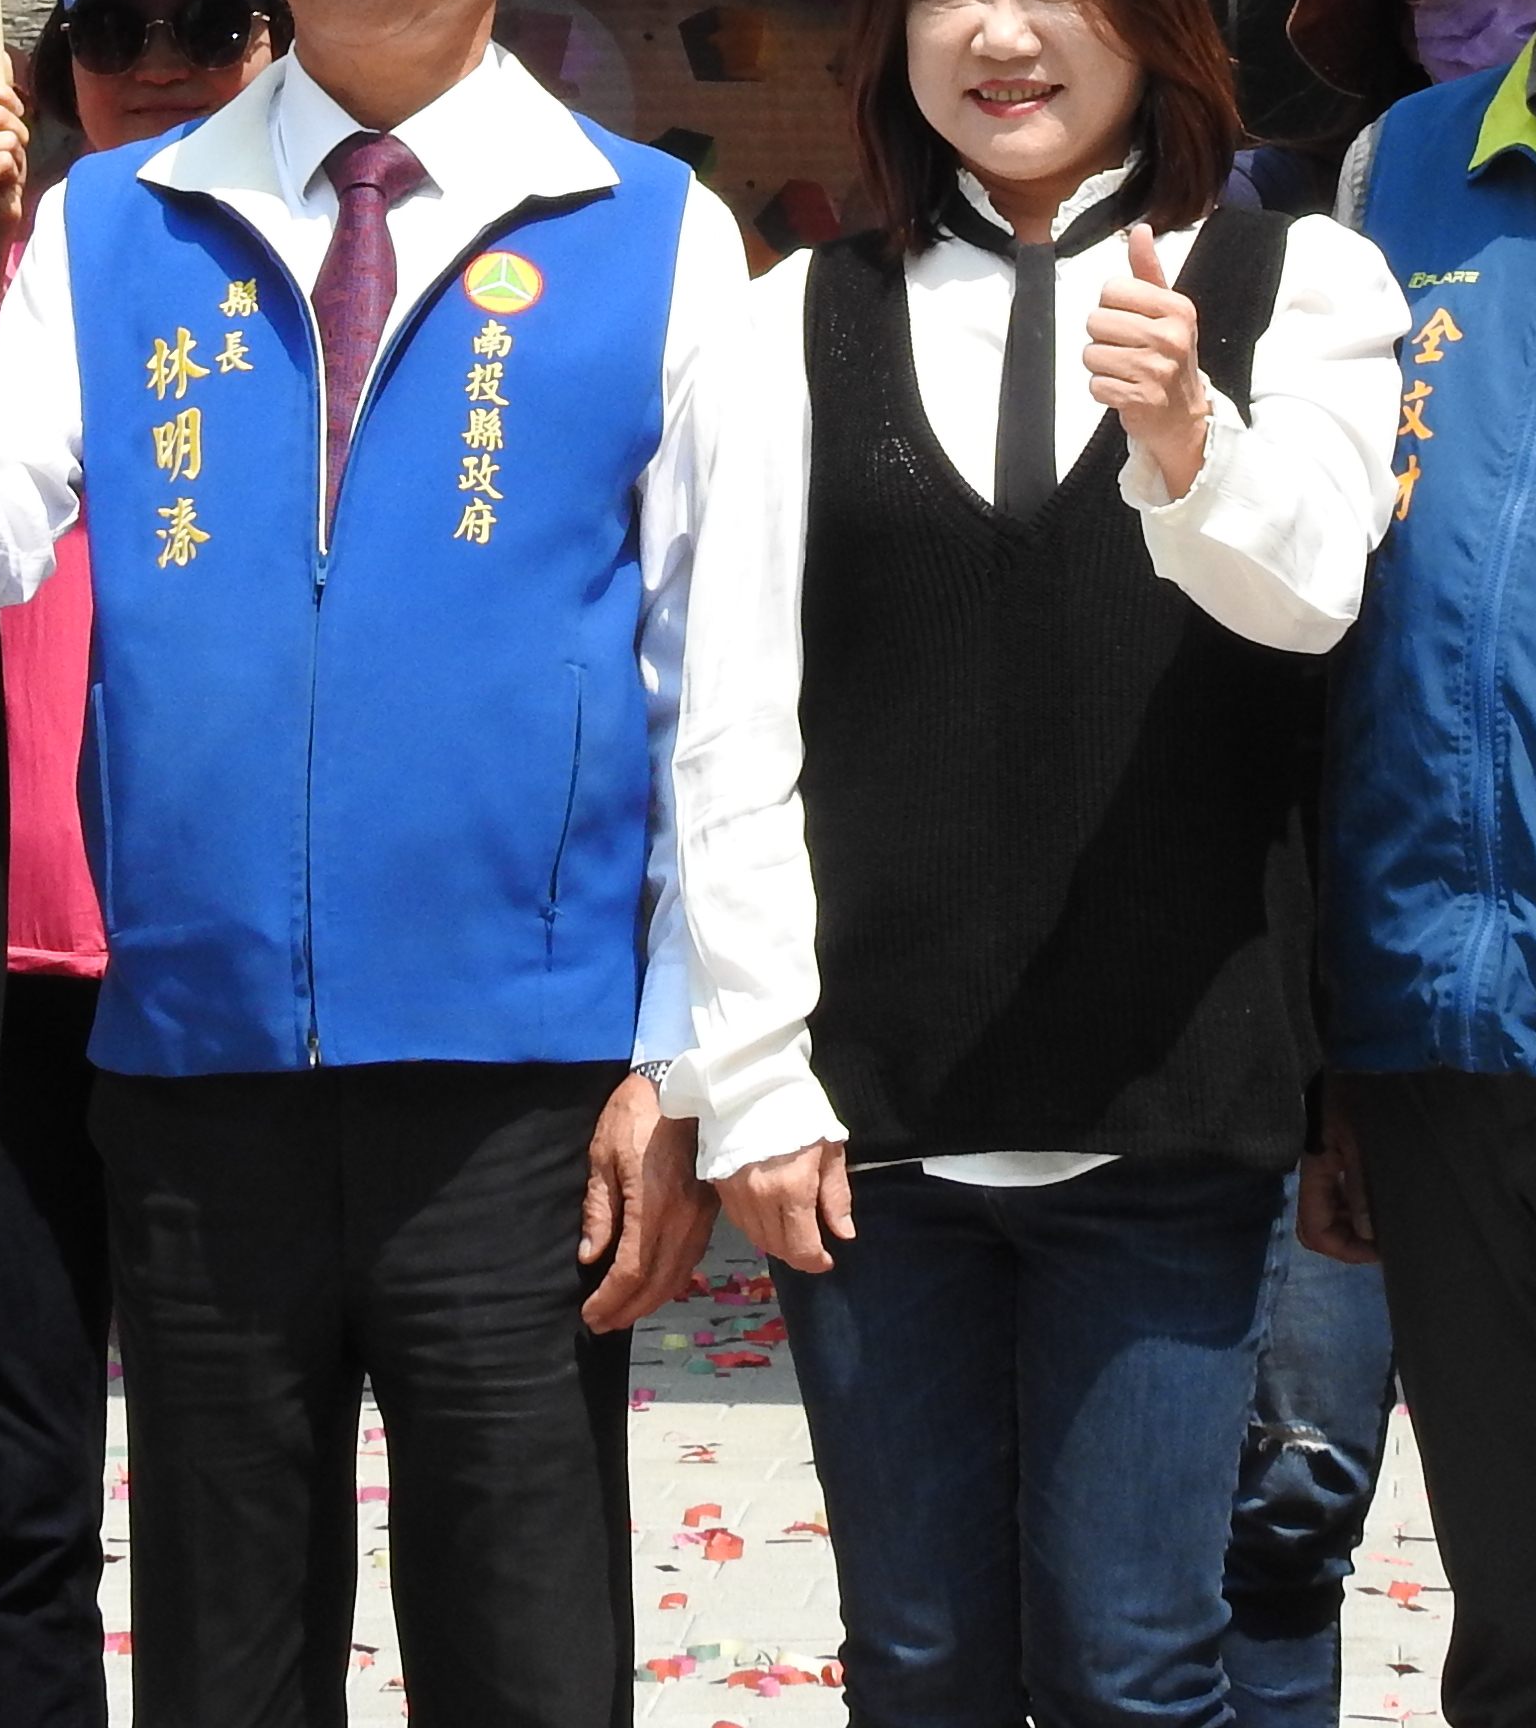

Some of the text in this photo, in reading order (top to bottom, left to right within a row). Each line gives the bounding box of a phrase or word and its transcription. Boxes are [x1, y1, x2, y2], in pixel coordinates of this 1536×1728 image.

[215, 278, 259, 373] 縣長
[453, 319, 514, 545] 南投縣政府
